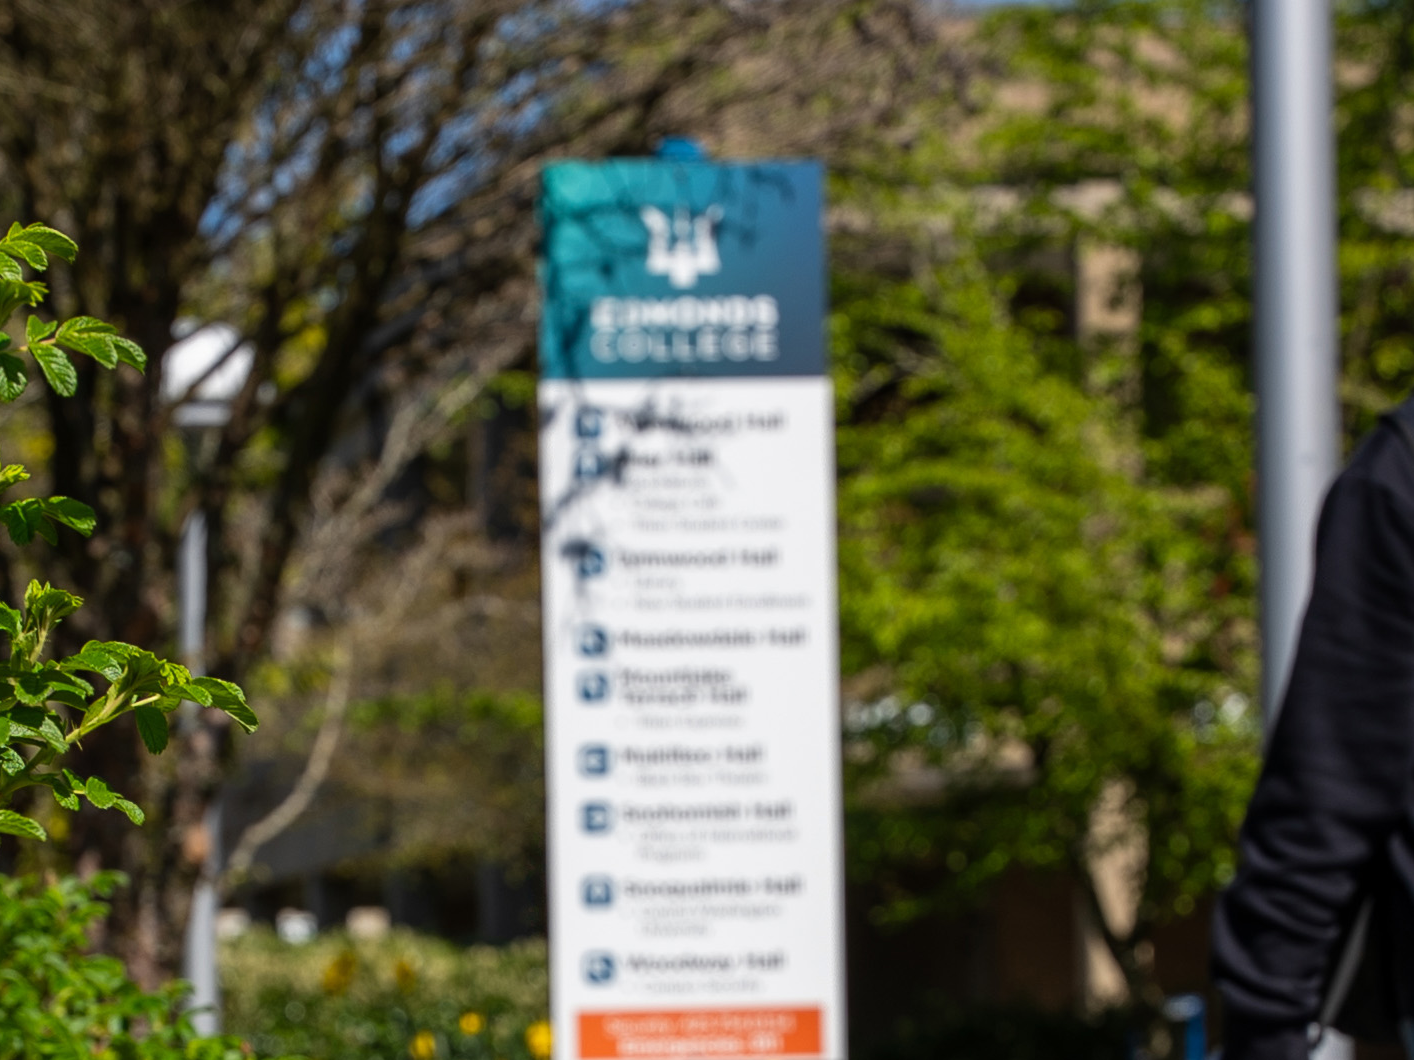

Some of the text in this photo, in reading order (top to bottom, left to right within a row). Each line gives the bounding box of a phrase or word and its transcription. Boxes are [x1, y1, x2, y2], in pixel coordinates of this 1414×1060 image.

[592, 296, 777, 330] EDMONDS
[592, 330, 777, 361] COLLEGE
[741, 410, 787, 433] Hall
[735, 547, 780, 568] Hall
[763, 627, 809, 648] Hall
[703, 686, 749, 707] Hall
[719, 744, 765, 765] Hall
[748, 801, 794, 822] Hall
[758, 875, 803, 896] Hall
[741, 950, 787, 972] Hall
